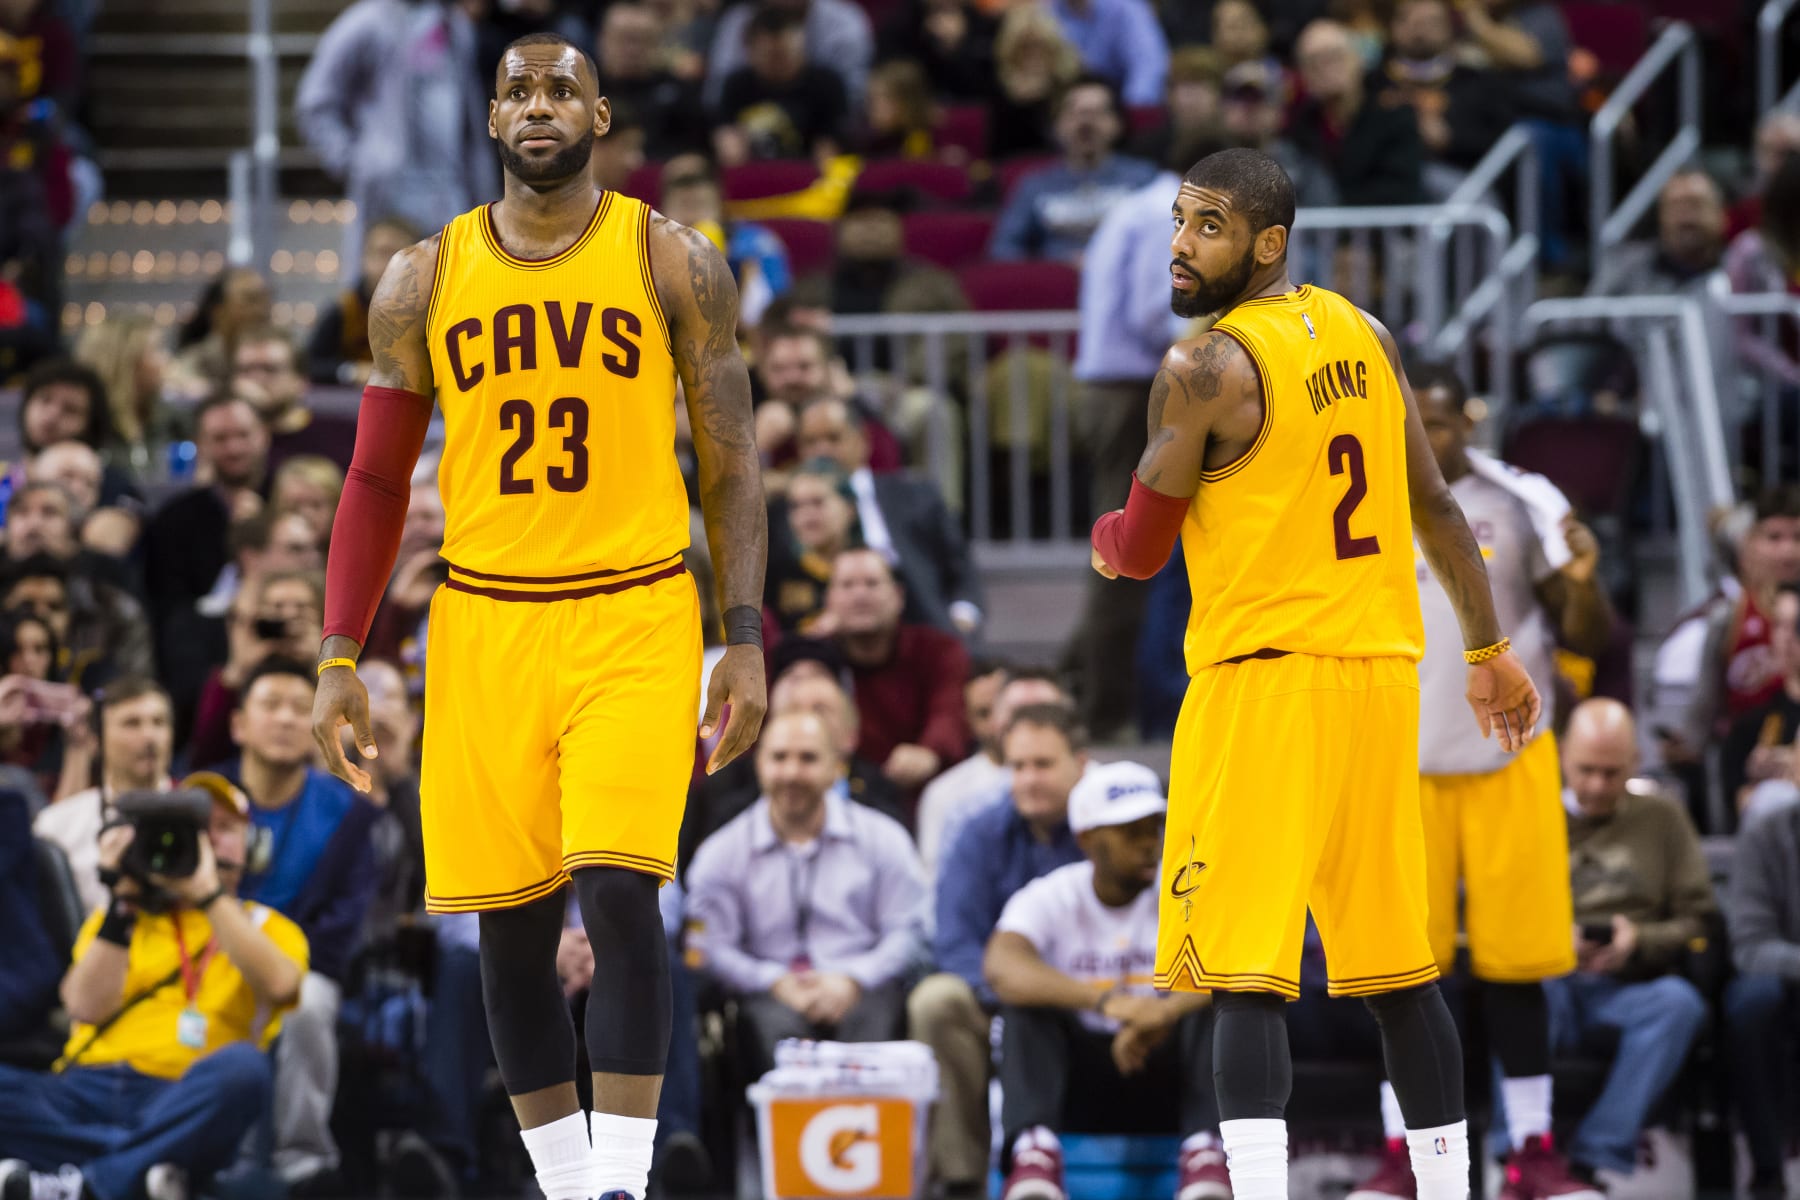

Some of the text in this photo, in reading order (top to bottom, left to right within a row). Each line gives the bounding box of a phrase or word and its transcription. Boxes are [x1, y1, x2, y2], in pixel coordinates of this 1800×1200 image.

[445, 301, 641, 392] CAVS
[1306, 360, 1367, 415] IRVING
[500, 397, 588, 495] 23
[1328, 434, 1381, 560] 2
[800, 1104, 881, 1193] G
